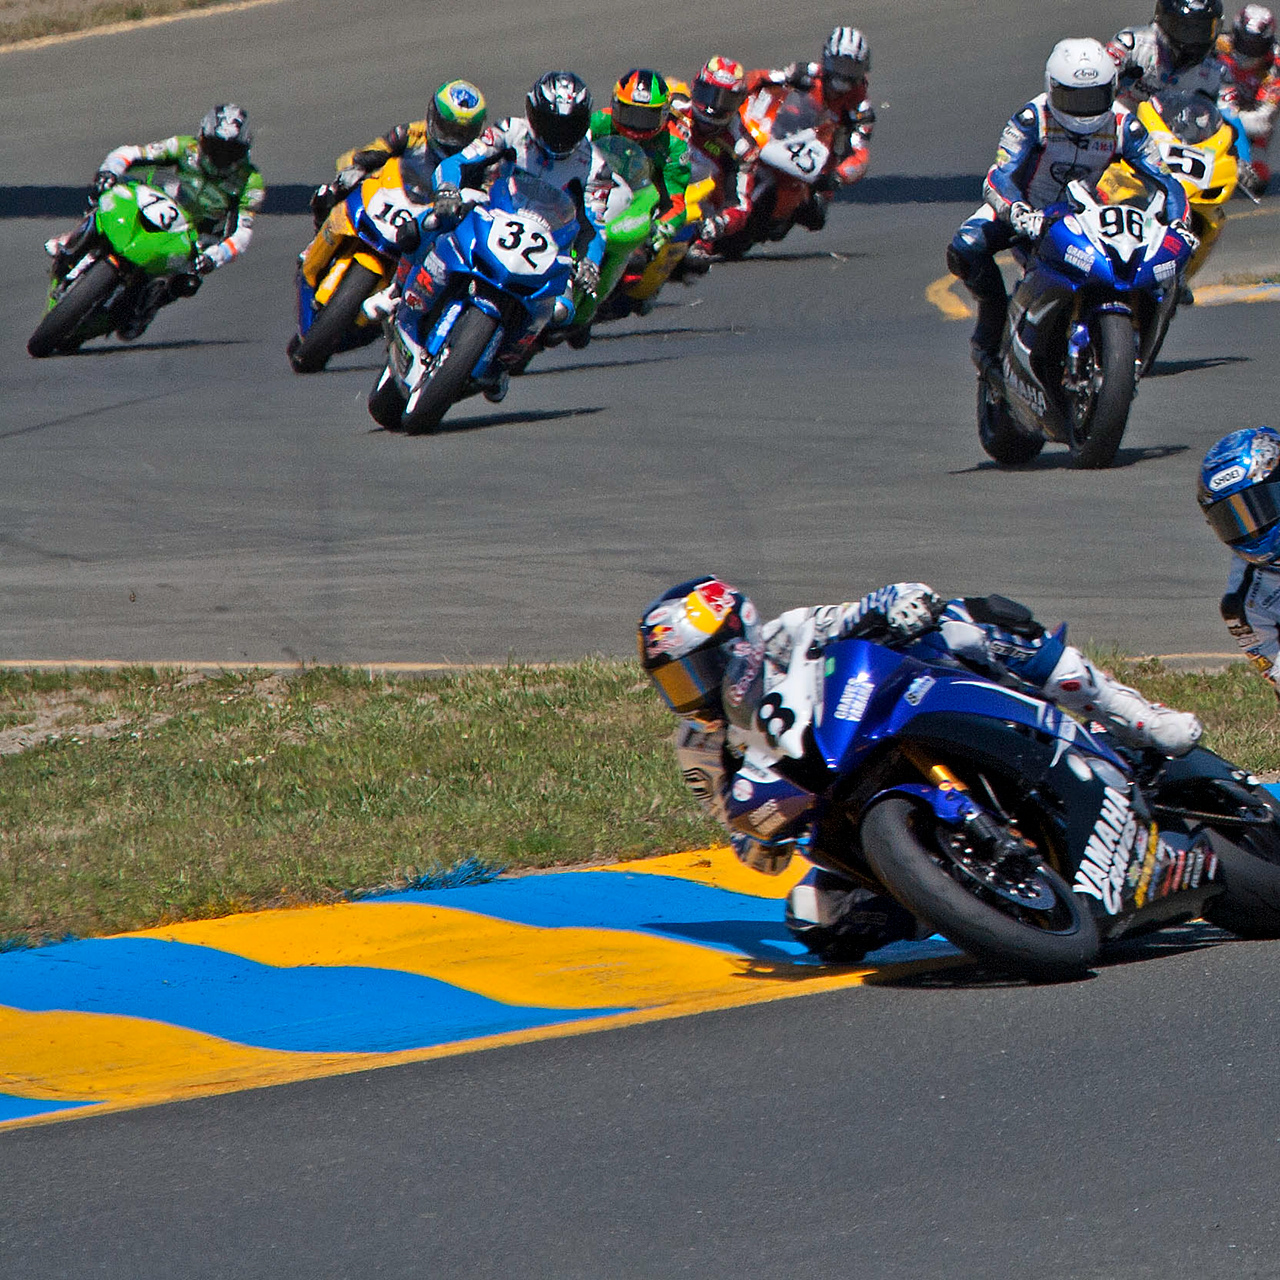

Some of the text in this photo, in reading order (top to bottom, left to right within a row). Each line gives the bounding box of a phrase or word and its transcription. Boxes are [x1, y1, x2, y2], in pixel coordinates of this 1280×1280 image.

[497, 220, 549, 270] 32
[1100, 206, 1144, 244] 96
[1212, 467, 1243, 490] SHOEI
[1072, 785, 1132, 901] YAMAHA
